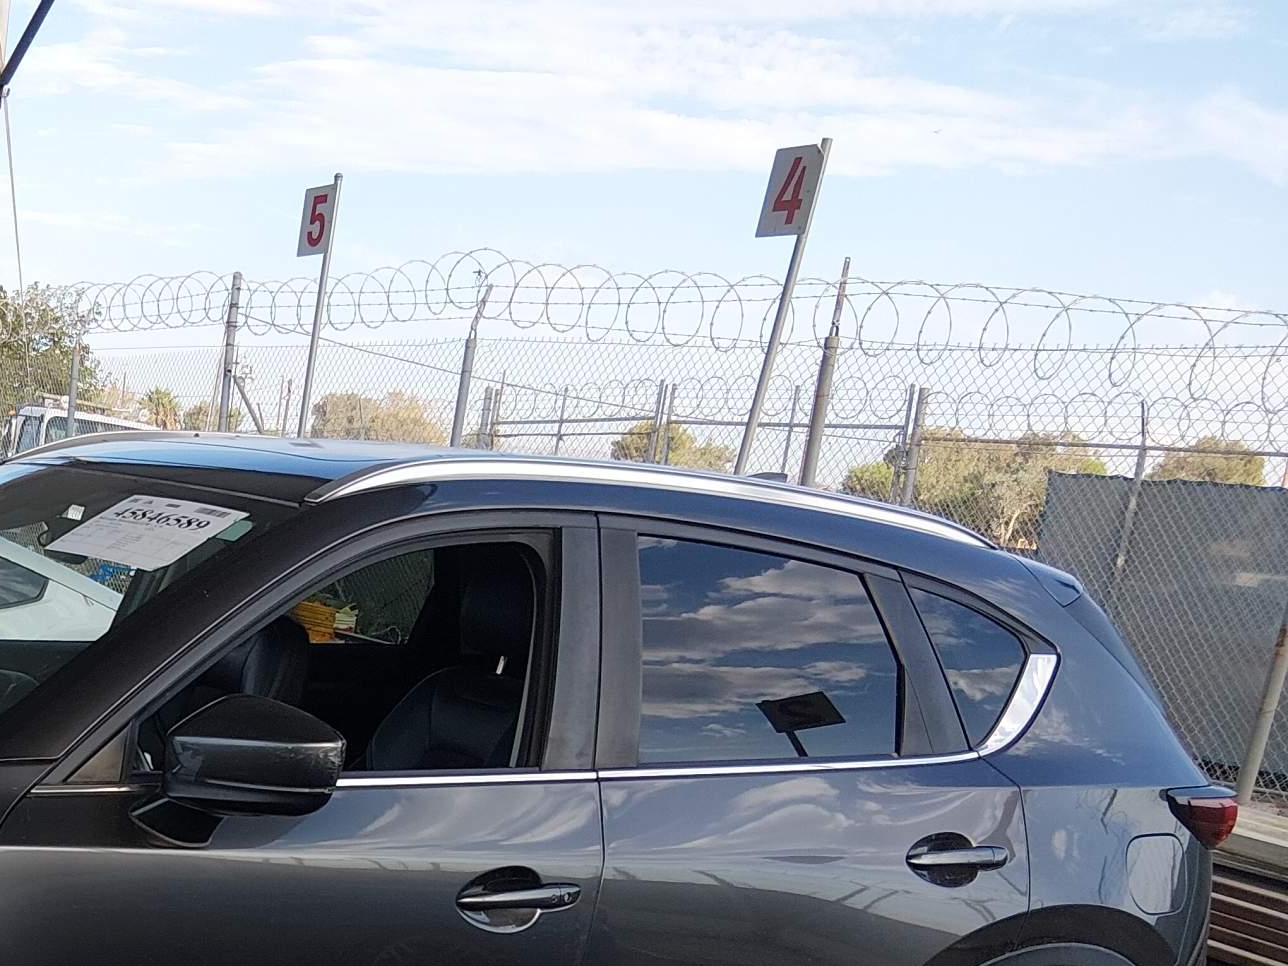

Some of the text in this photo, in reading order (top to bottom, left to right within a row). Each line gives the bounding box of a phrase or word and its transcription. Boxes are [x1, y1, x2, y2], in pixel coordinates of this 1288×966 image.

[772, 156, 807, 225] 4
[307, 193, 329, 248] 5
[114, 507, 211, 531] 45846589
